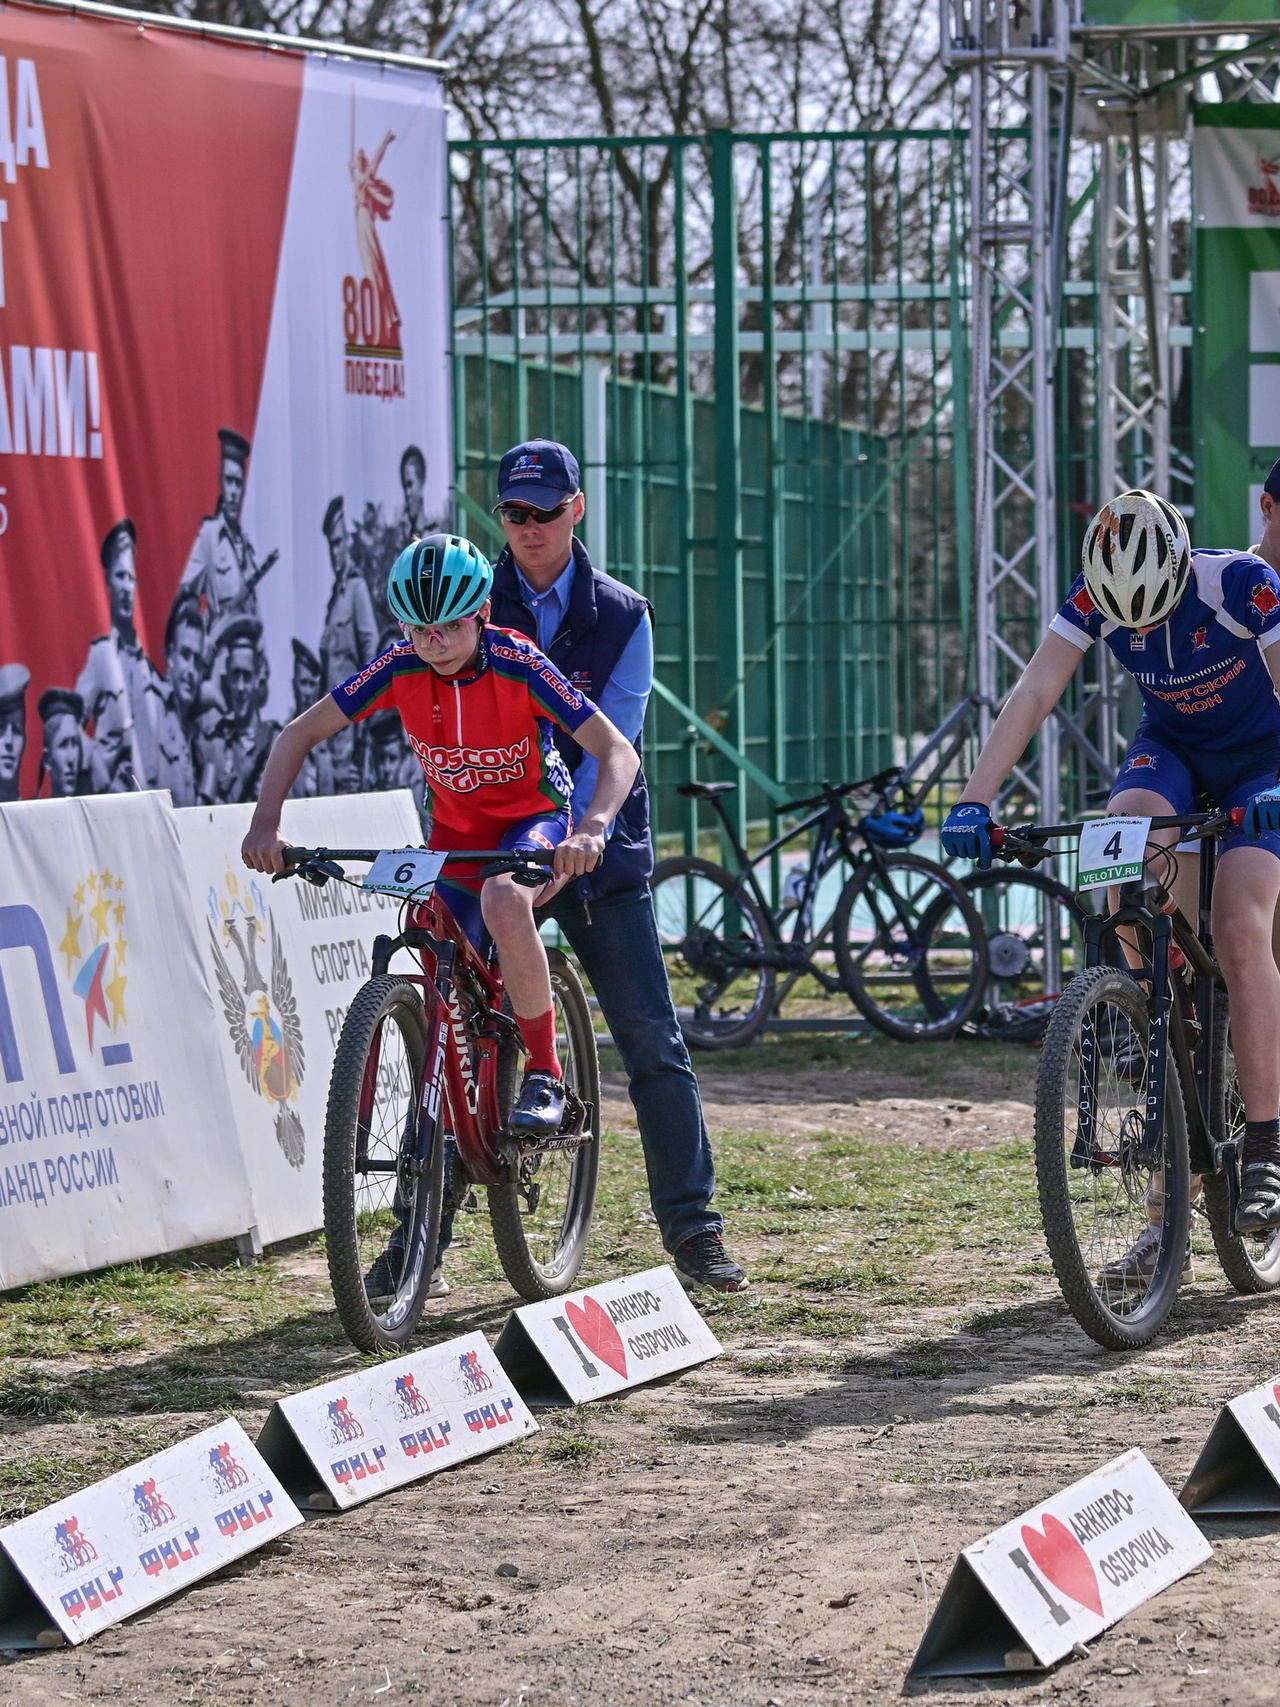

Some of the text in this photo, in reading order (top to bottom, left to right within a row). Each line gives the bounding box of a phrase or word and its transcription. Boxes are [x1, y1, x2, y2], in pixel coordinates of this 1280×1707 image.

[343, 275, 382, 346] 80
[345, 360, 405, 401] ПОБЕДА!
[491, 643, 583, 711] MOSCOW REGION
[408, 734, 530, 772] MOSCOW
[421, 762, 525, 794] REGION
[1103, 831, 1122, 860] 4
[394, 862, 416, 884] 6
[1083, 866, 1138, 883] VELOTV.RU
[311, 938, 371, 985] СПОРТА
[1078, 1021, 1095, 1126] MANITOU
[1147, 1017, 1162, 1122] MANITOU
[47, 1080, 165, 1139] ПОДГОТОВКИ
[44, 1147, 119, 1196] РОССИИ
[605, 1288, 662, 1324] ARKHIPO-
[627, 1323, 692, 1361] OSIPOVKA
[1069, 1488, 1134, 1545] ARKHIPO-
[1099, 1526, 1174, 1587] OSIPOVKA
